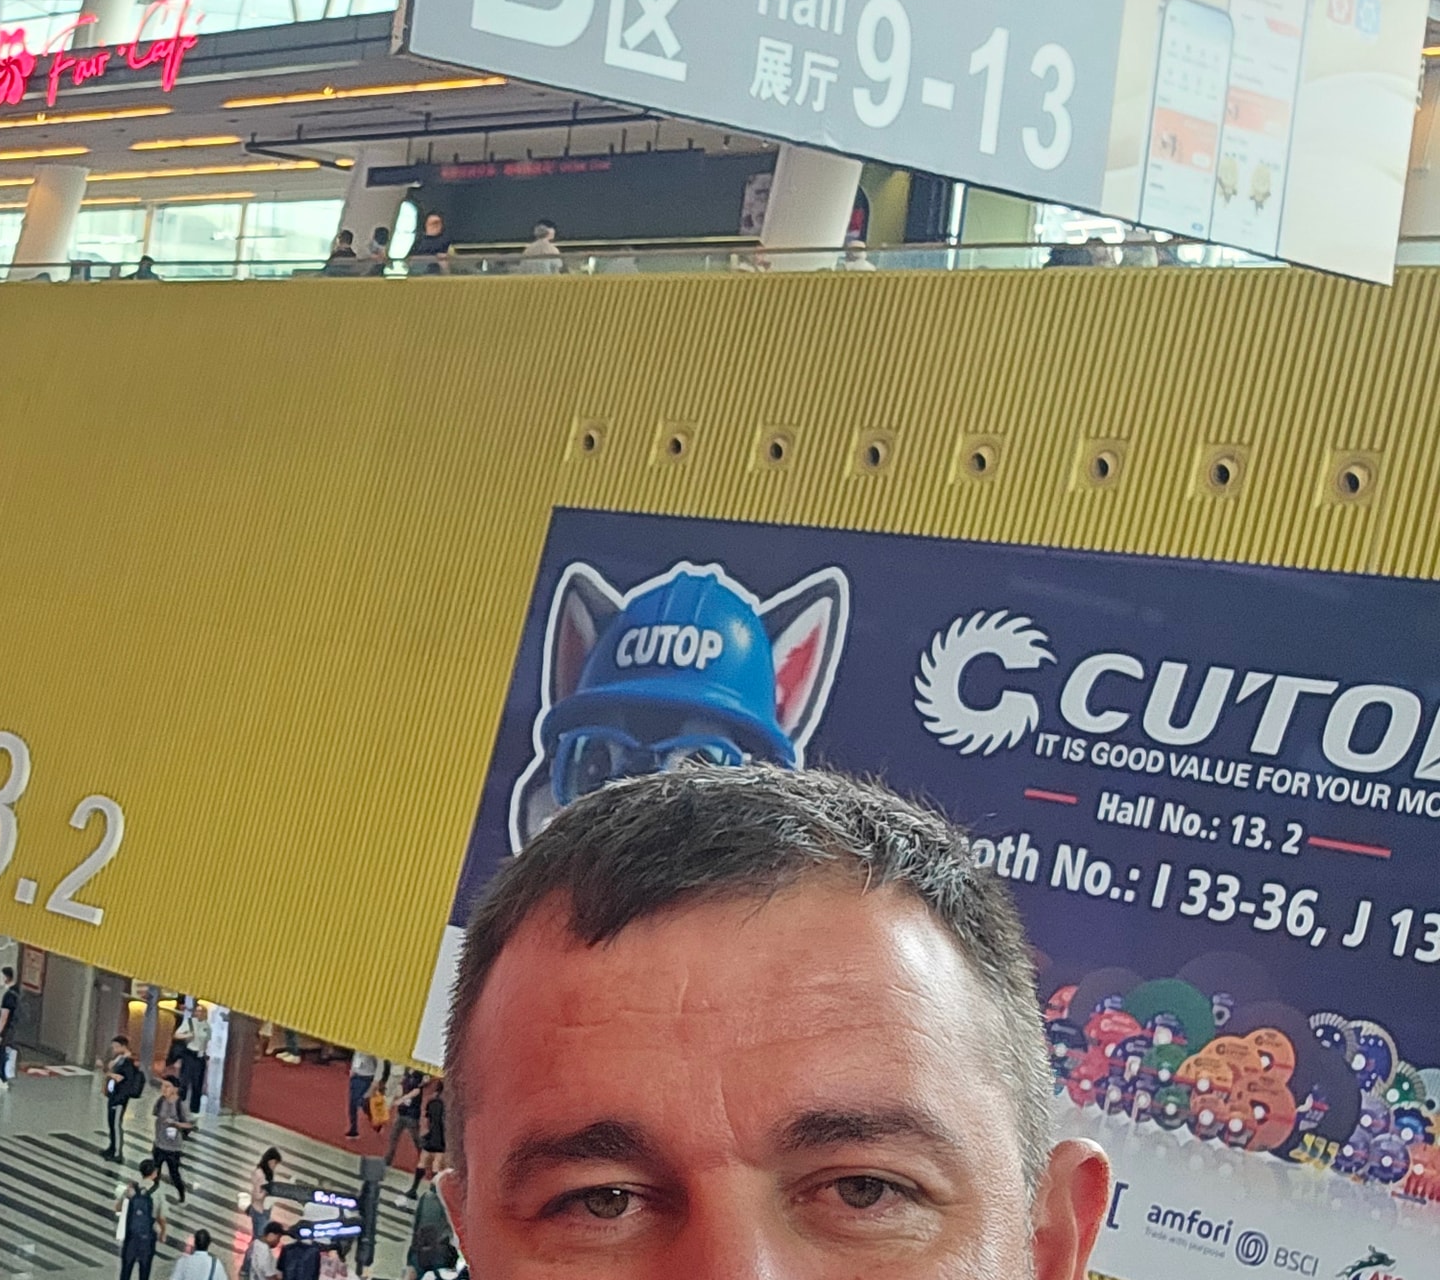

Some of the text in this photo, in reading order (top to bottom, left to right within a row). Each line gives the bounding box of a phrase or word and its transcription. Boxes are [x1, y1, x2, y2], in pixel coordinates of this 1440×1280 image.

[749, 35, 840, 113] 展厅
[616, 625, 723, 669] CUTOP
[1035, 731, 1060, 757] IT
[1062, 737, 1087, 764] IS
[1090, 740, 1166, 775] GOOD
[1169, 752, 1252, 789] VALUE
[1255, 765, 1311, 798] FOR
[1312, 773, 1392, 811] YOUR
[1097, 791, 1156, 830] Hall
[1158, 801, 1220, 842] No.:
[1050, 842, 1142, 903] No.:
[1151, 862, 1172, 909] I
[1180, 868, 1327, 947] 33-36,
[1342, 900, 1372, 947] J
[1146, 1202, 1234, 1246] amfori
[1274, 1246, 1319, 1278] BSCI
